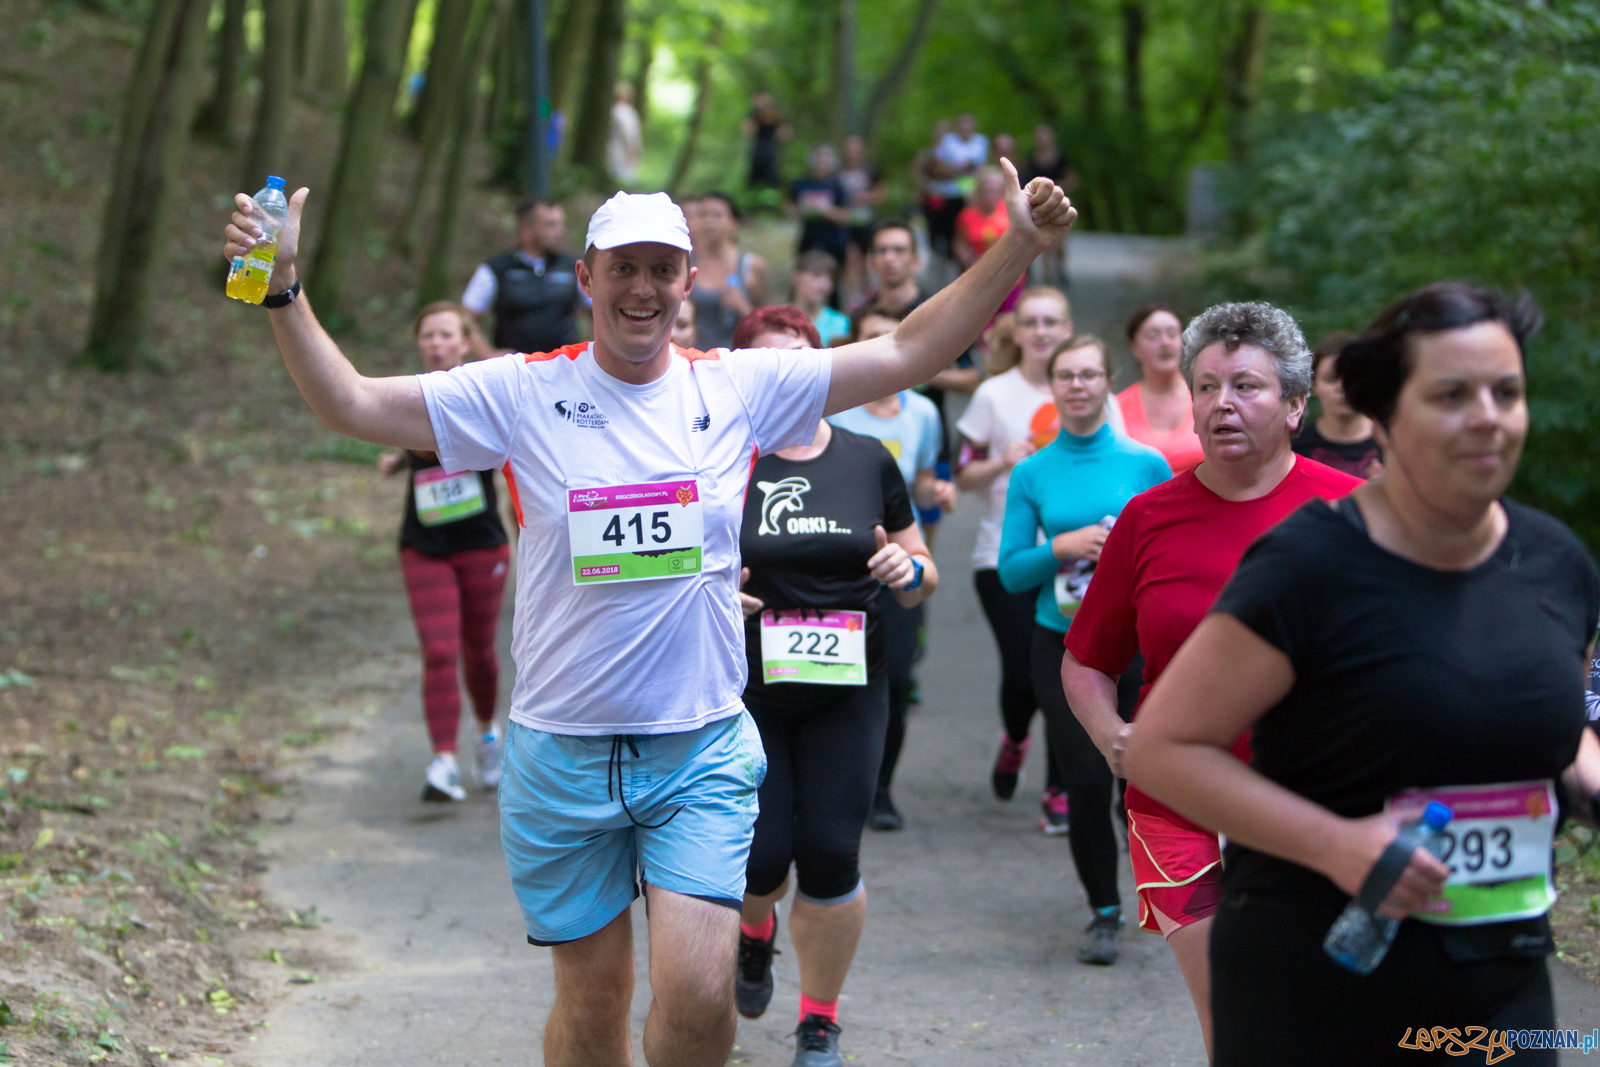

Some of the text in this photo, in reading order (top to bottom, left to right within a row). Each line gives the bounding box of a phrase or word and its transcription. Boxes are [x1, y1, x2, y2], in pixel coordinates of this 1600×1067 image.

[602, 511, 672, 547] 415
[786, 516, 827, 535] ORKI
[582, 566, 619, 576] 22.06.2018
[787, 631, 839, 657] 222
[1439, 826, 1513, 872] 293
